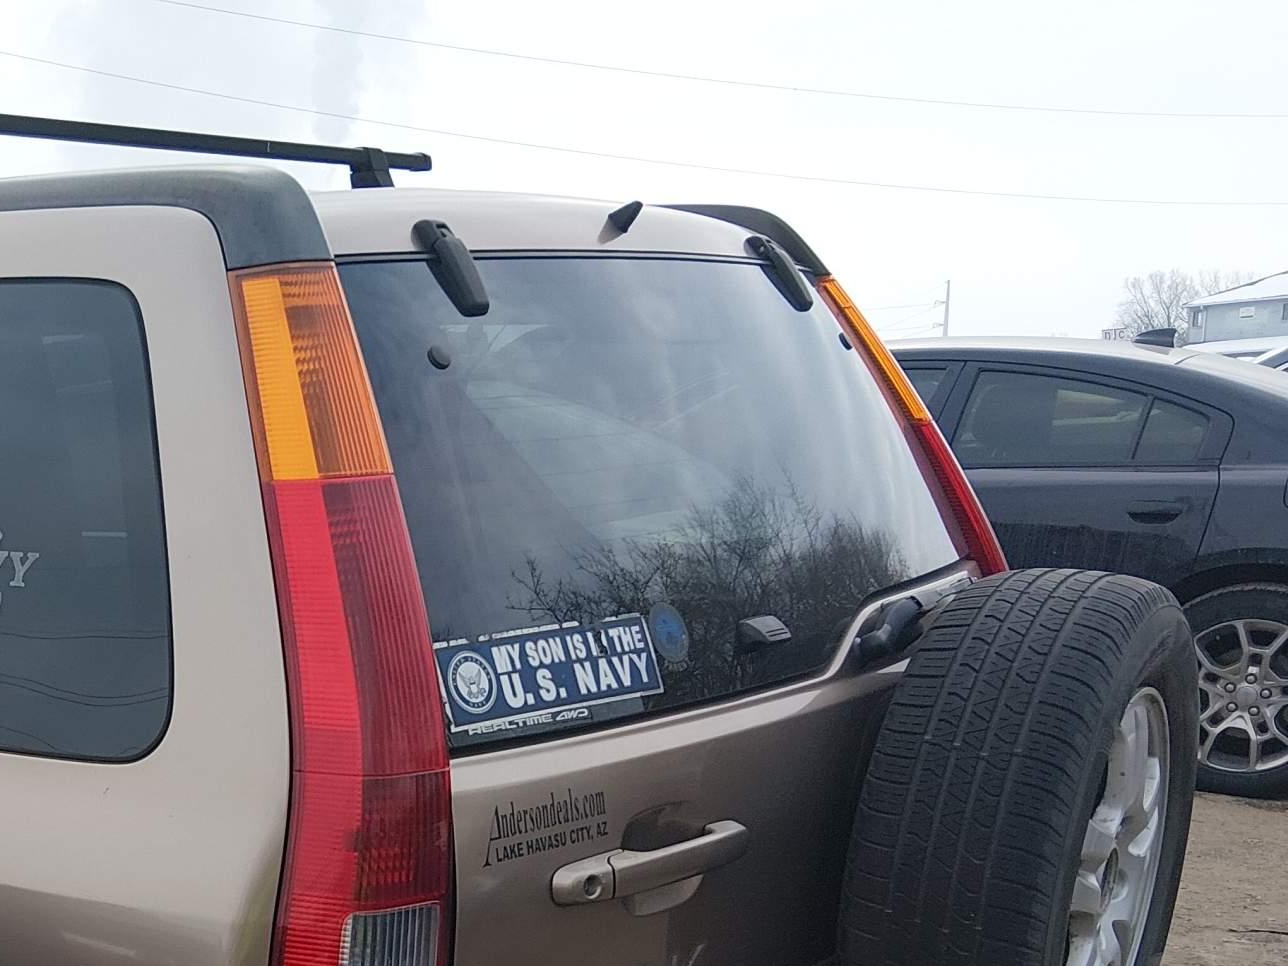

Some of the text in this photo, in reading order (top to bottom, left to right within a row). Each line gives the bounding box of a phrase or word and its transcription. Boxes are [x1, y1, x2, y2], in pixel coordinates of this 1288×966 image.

[491, 644, 522, 674] MY
[525, 637, 566, 667] SON
[565, 632, 586, 661] IS
[607, 625, 645, 653] THE
[499, 669, 568, 709] U.S.
[572, 652, 648, 695] NAVY
[482, 788, 606, 868] Andersondeals.com
[495, 842, 524, 862] LAKE
[526, 831, 567, 856] HAVASU
[596, 821, 609, 837] AZ
